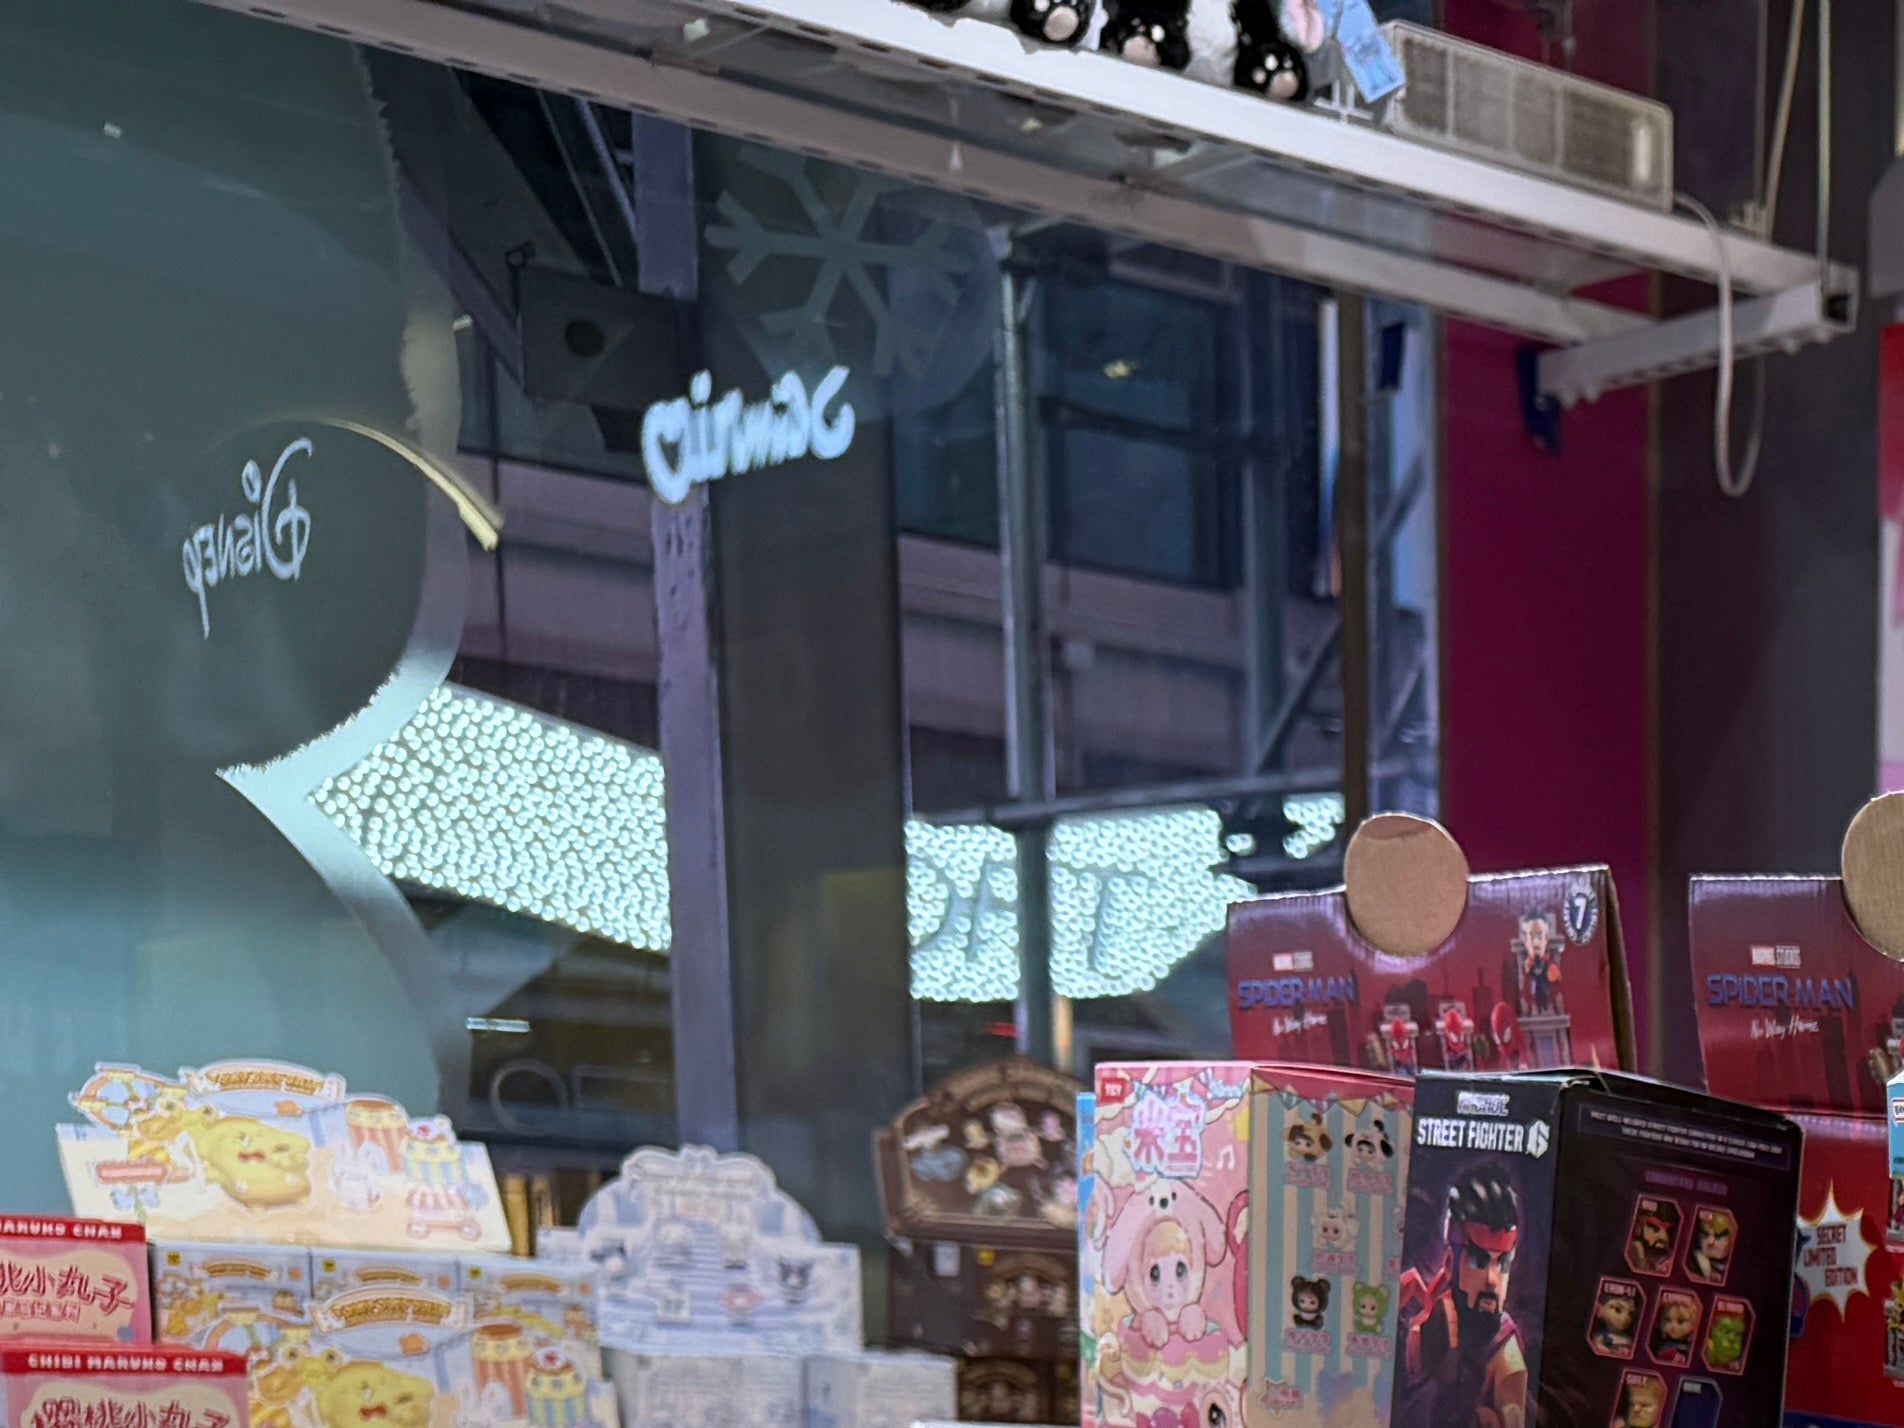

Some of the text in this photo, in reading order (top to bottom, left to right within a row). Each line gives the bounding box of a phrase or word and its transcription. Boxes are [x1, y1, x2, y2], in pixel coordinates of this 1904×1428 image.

[1417, 1118, 1467, 1149] STREET
[1468, 1122, 1523, 1152] FIGHTER
[1816, 1225, 1846, 1245] SECRET
[1804, 1246, 1837, 1268] LIMITED
[1824, 1266, 1858, 1288] EDITION
[28, 1354, 224, 1373] CHIBI MARUKO CHAN
